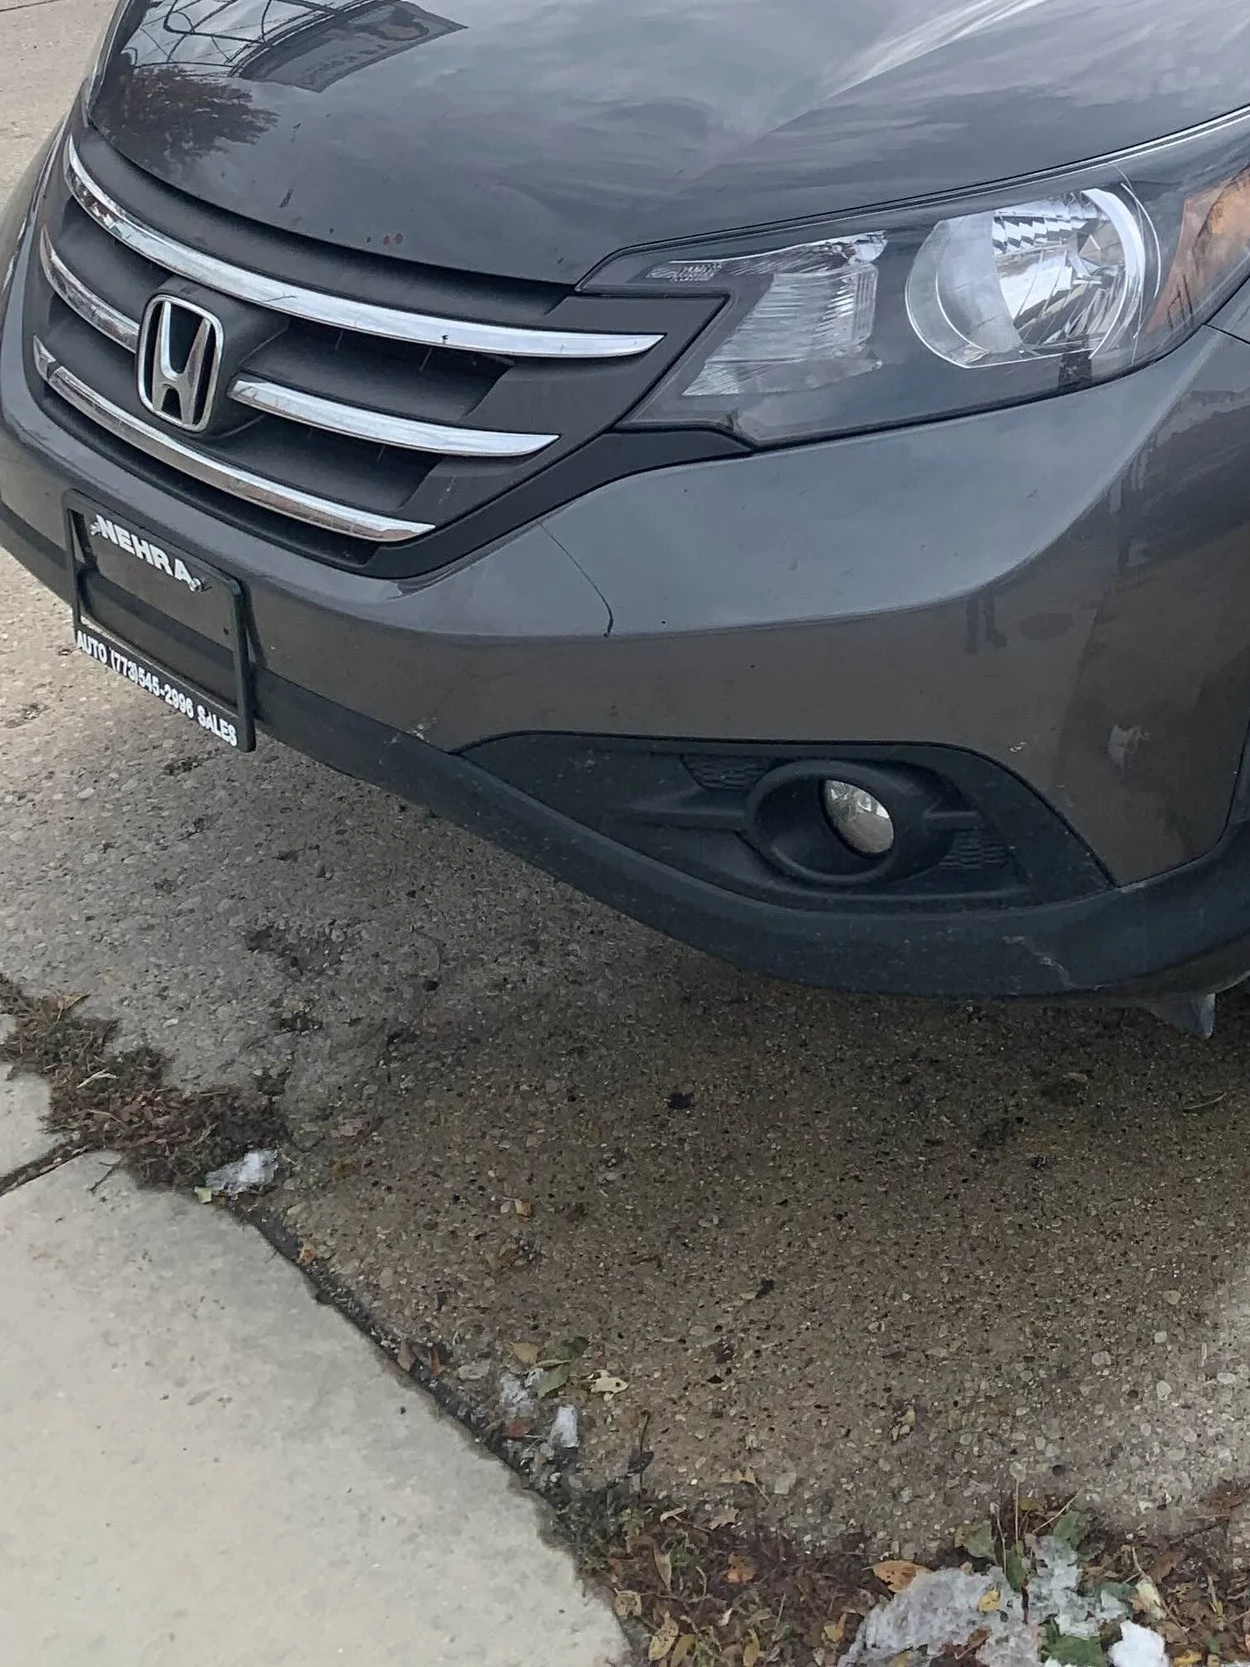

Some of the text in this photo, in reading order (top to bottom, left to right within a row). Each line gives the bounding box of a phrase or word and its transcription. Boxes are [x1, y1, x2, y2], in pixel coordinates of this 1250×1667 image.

[95, 514, 195, 585] NEHRA
[77, 630, 108, 664] AUTO
[197, 705, 238, 747] SALES
